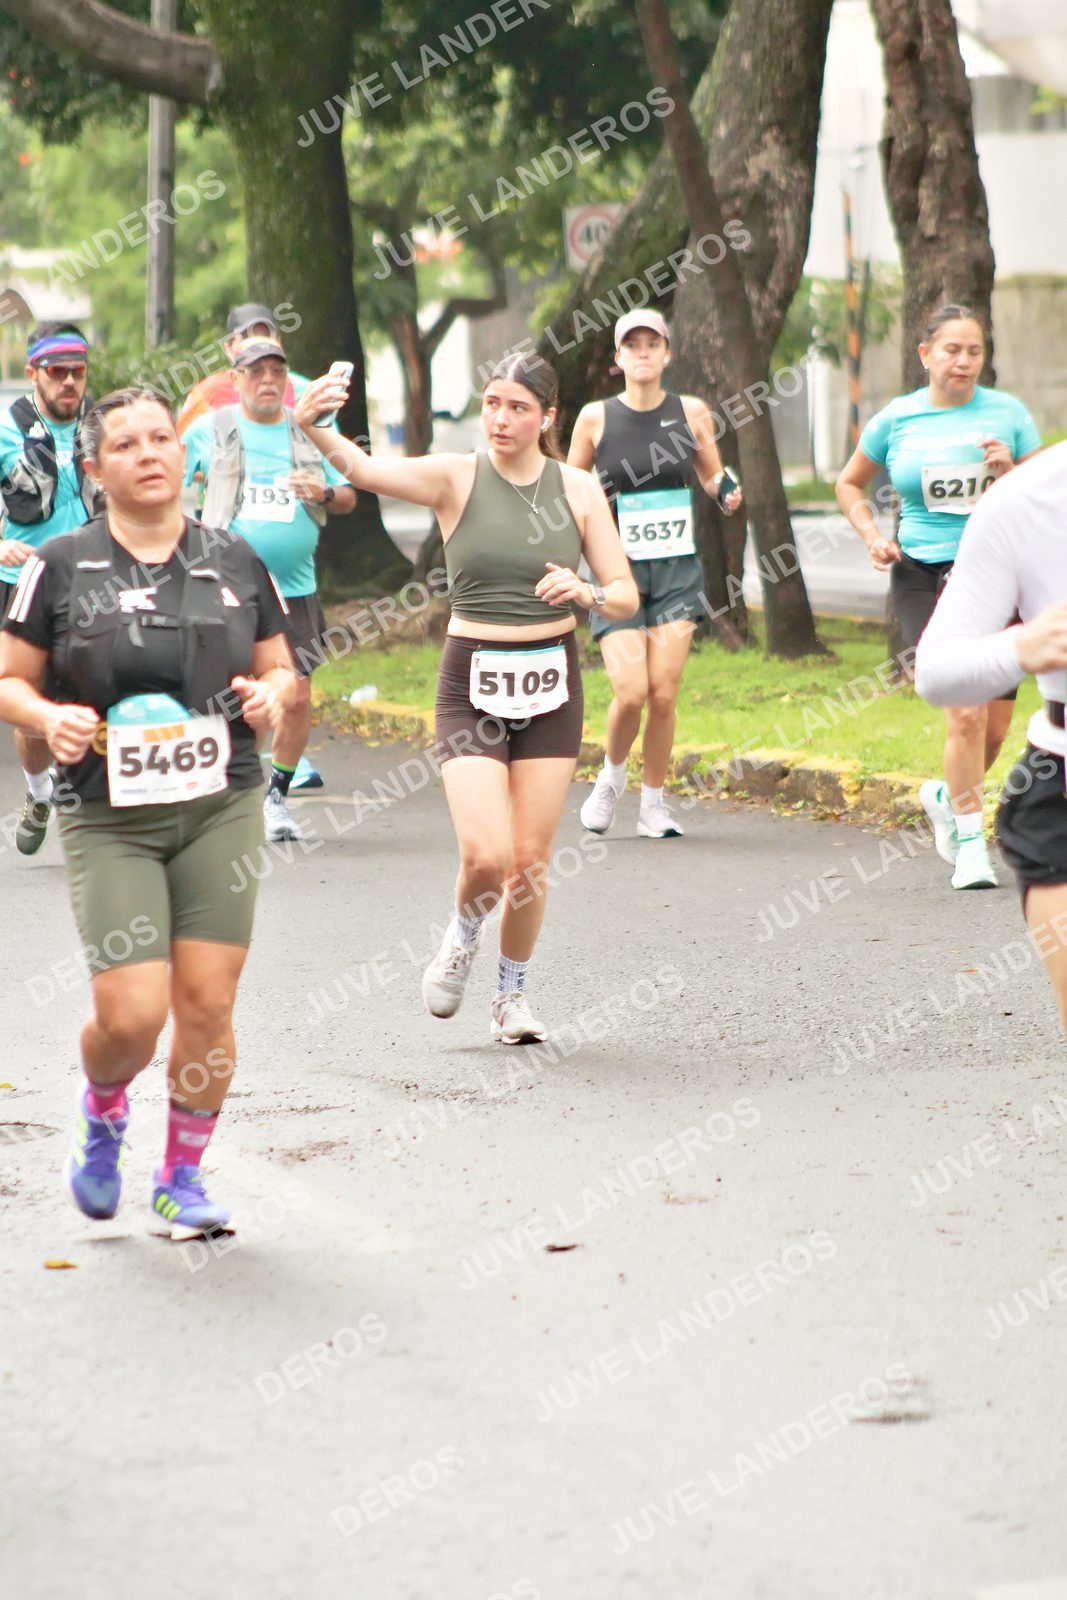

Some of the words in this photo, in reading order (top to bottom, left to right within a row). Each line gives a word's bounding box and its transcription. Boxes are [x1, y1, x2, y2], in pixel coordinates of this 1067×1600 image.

[242, 487, 290, 506] 193
[627, 520, 686, 542] 3637
[478, 668, 559, 697] 5109
[119, 736, 219, 777] 5469
